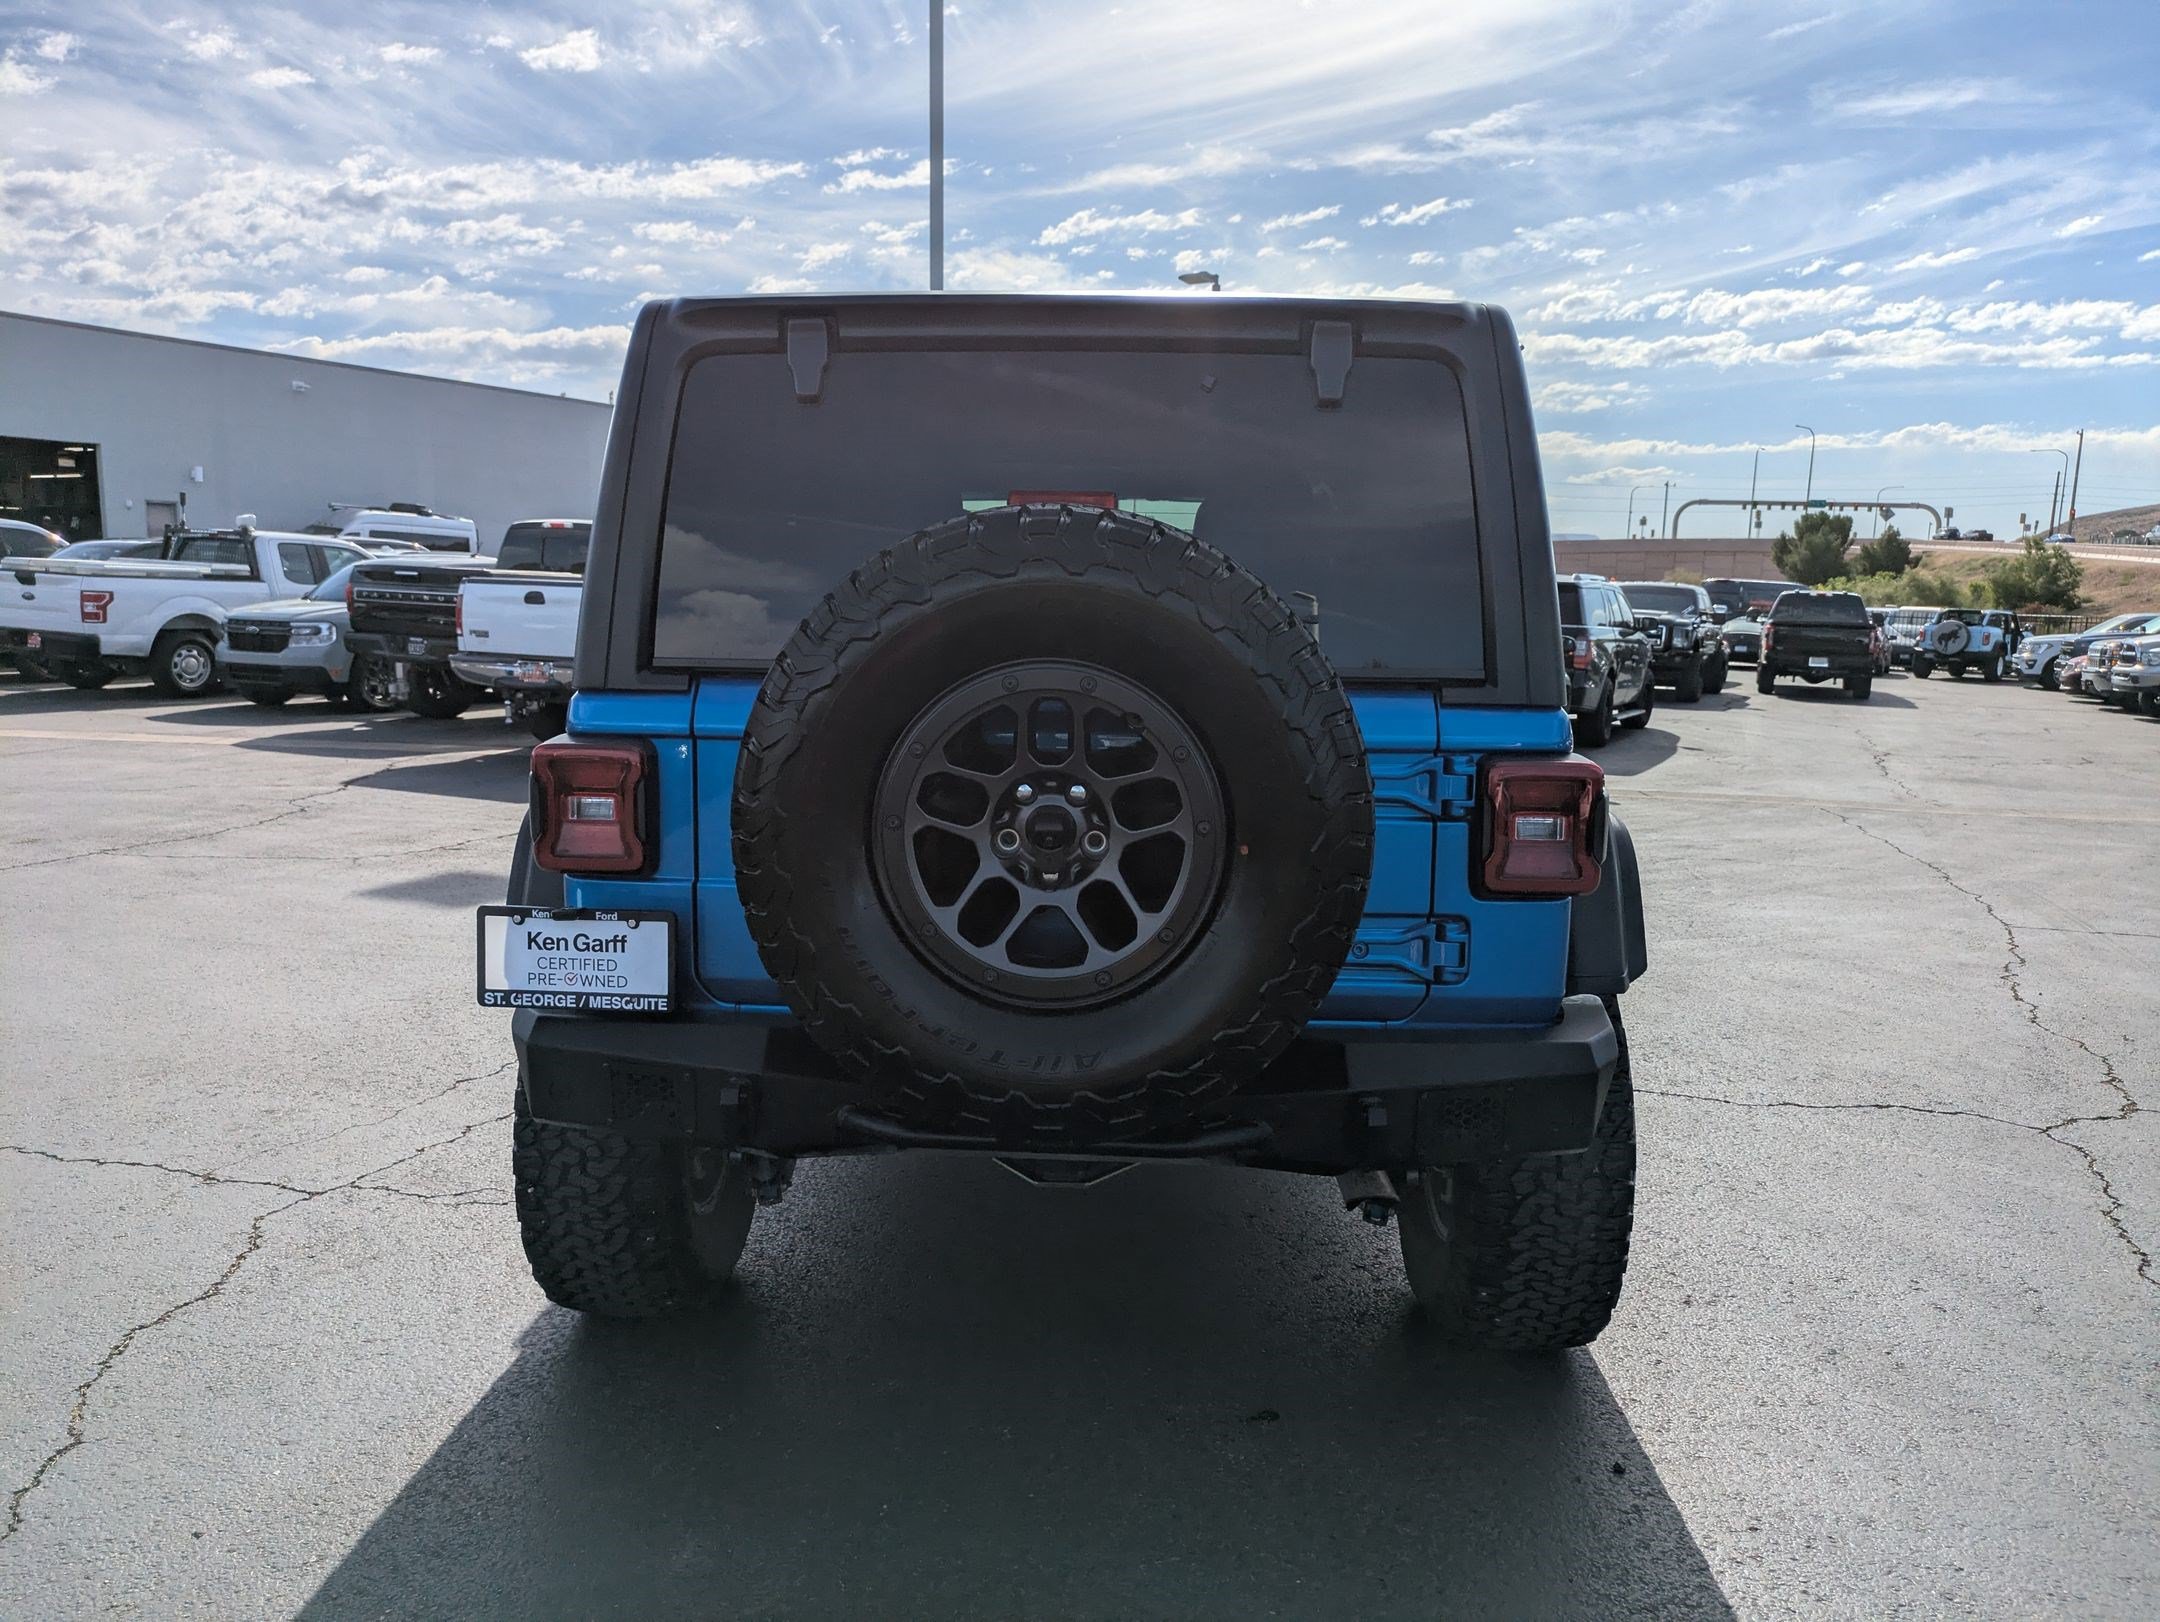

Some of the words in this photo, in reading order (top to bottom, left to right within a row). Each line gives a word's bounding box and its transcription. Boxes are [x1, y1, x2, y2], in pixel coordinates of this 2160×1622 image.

[532, 909, 550, 918] Ken
[595, 911, 618, 921] Ford
[527, 931, 569, 951] Ken
[573, 933, 628, 953] Garff
[537, 956, 618, 972] CERTIFIED
[484, 992, 506, 1005] ST.
[510, 993, 576, 1007] GEORGE
[579, 995, 585, 1008] /
[589, 997, 668, 1011] MESQUITE
